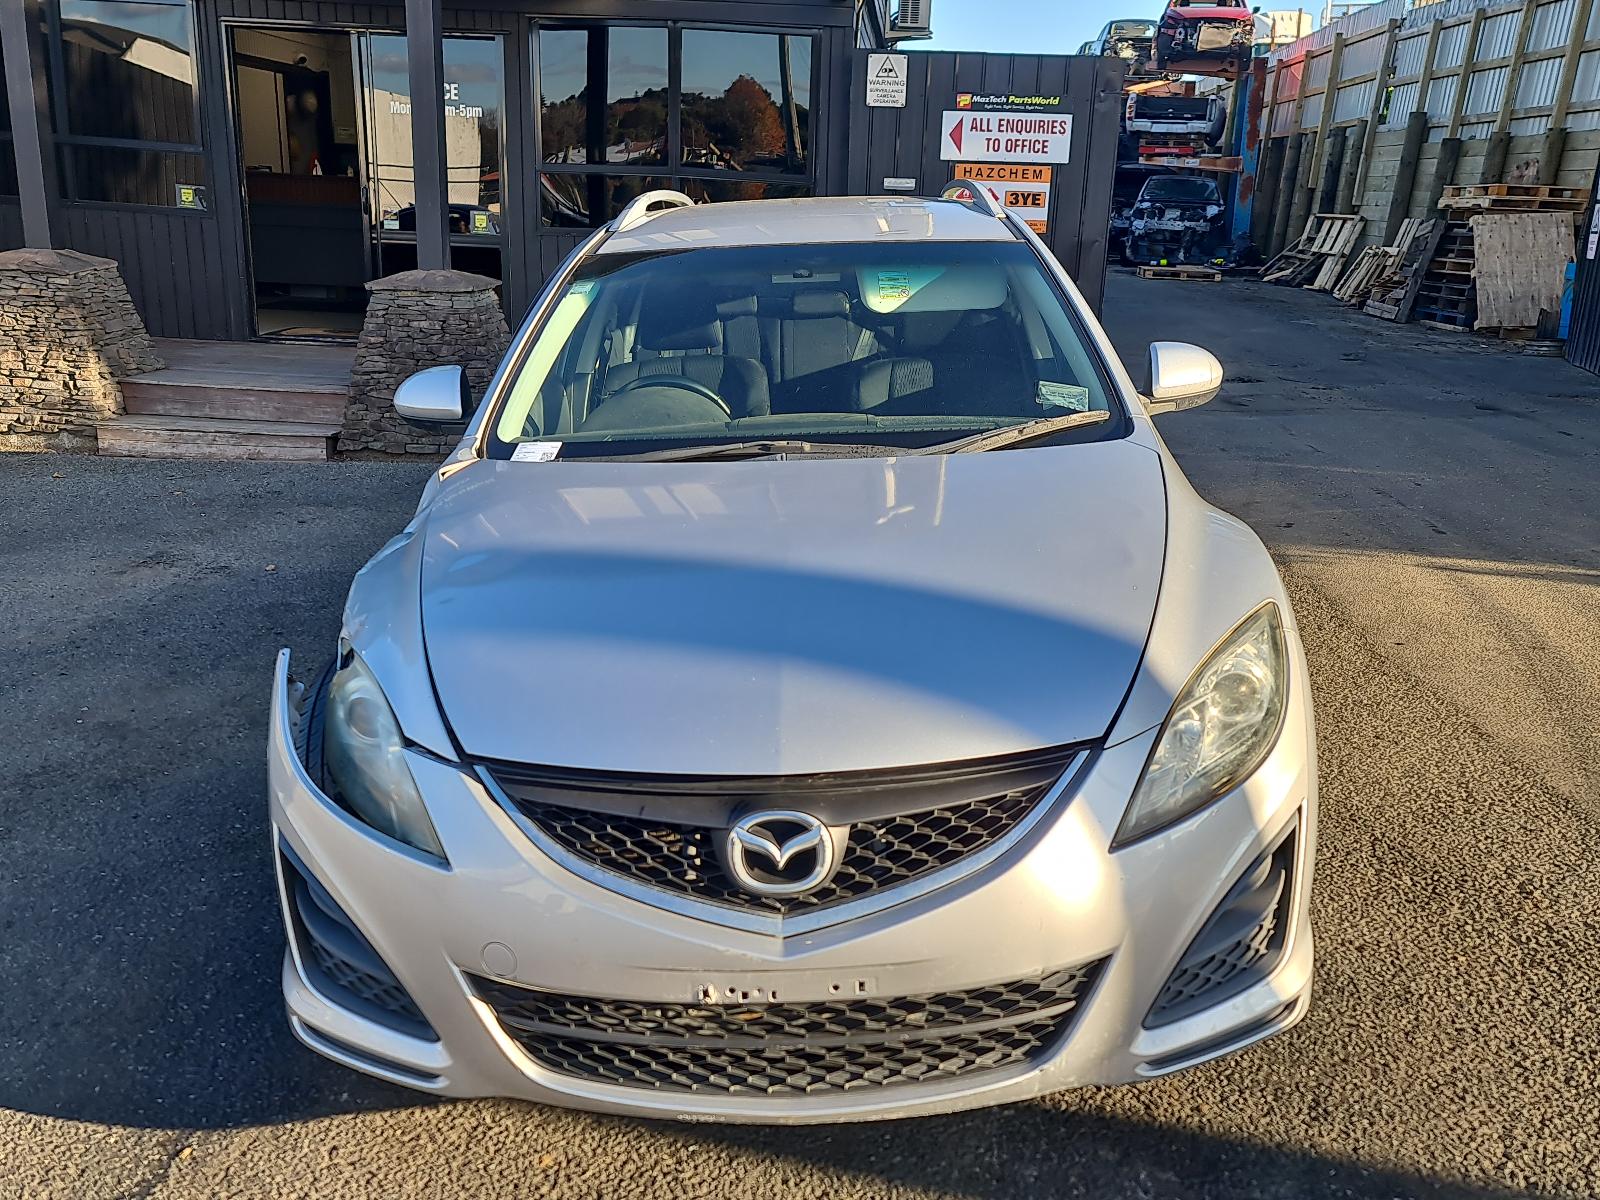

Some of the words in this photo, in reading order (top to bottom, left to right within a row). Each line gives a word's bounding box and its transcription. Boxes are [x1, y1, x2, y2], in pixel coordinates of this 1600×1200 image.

[869, 79, 905, 87] WARNING
[972, 95, 1007, 103] MazTech
[1008, 95, 1060, 105] PartsWorld
[970, 117, 993, 133] ALL
[997, 118, 1067, 136] ENQUIRIES
[985, 137, 1001, 153] TO
[1005, 138, 1049, 154] OFFICE
[963, 166, 1043, 180] HAZCHEM
[1009, 192, 1042, 206] 3YE
